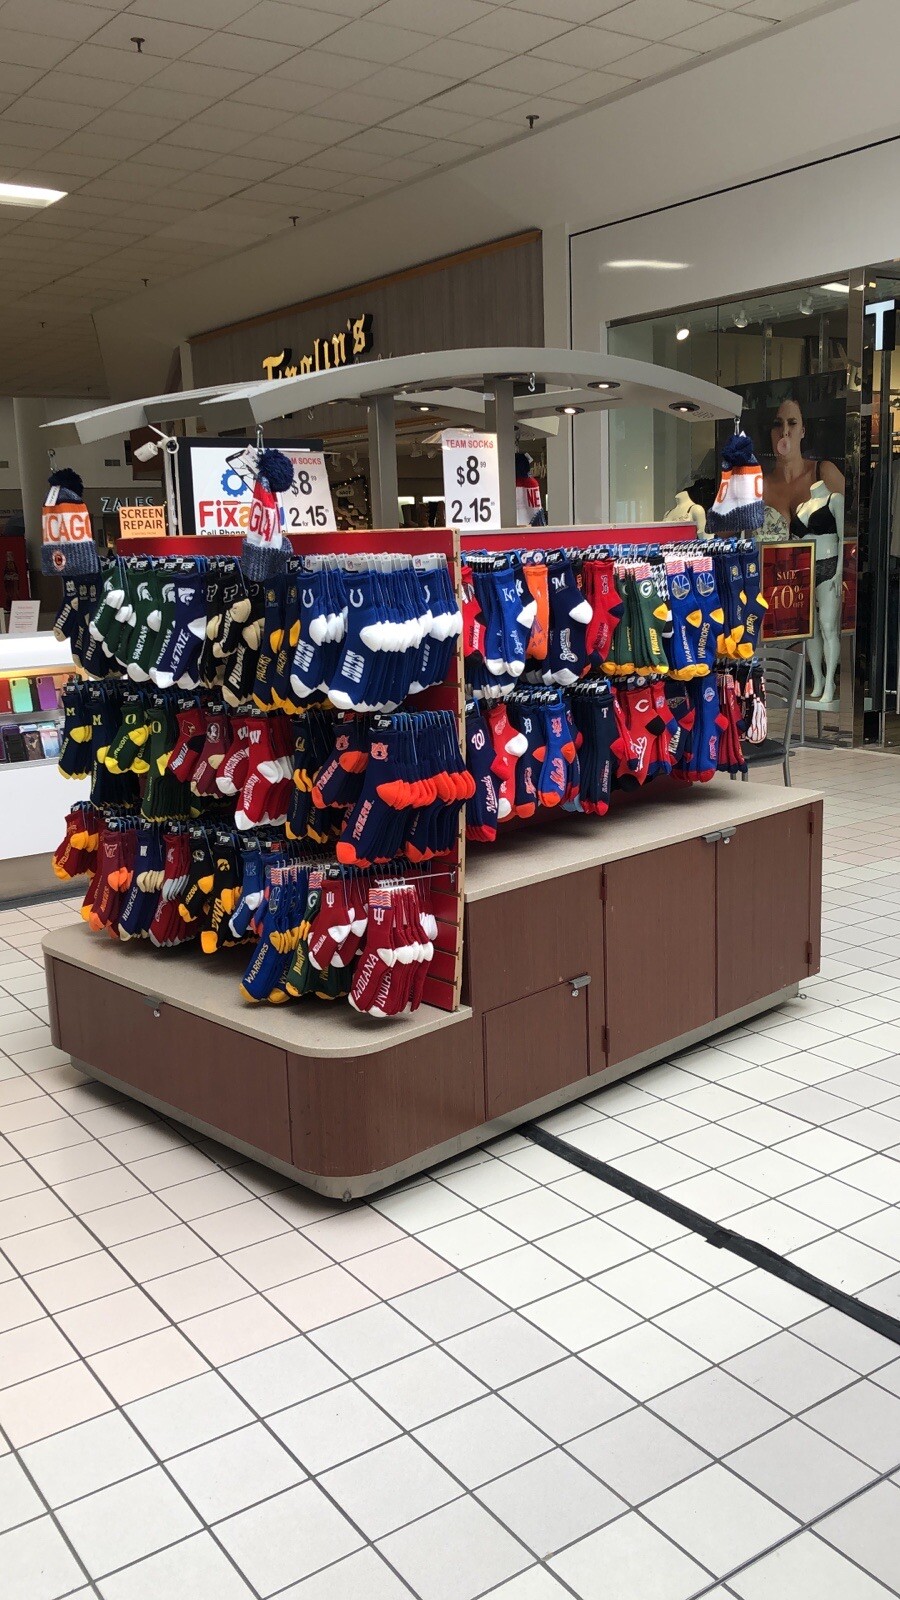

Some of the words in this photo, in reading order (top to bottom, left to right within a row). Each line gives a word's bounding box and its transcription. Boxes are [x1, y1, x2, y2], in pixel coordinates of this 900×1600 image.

[446, 439, 466, 449] TEAM
[467, 440, 494, 449] SOCKS
[298, 457, 322, 465] SOCKS
[101, 496, 154, 512] ZALES
[121, 508, 163, 519] SCREEN
[451, 500, 464, 523] 2
[123, 519, 163, 530] REPAIR
[289, 507, 301, 527] 2
[777, 570, 798, 581] SALE
[55, 603, 72, 629] IRISH
[132, 624, 148, 661] SPARTANS
[169, 629, 189, 673] K-STATE
[697, 622, 711, 660] WARRIORS
[255, 653, 272, 684] PACERS
[341, 649, 365, 684] COLTS
[66, 707, 75, 716] M
[601, 707, 609, 719] T
[634, 698, 650, 713] C
[92, 714, 103, 726] M
[125, 713, 137, 725] O
[152, 720, 162, 734] O
[249, 729, 262, 745] W
[471, 729, 485, 751] W
[316, 759, 338, 791] TIGERS
[550, 757, 565, 791] Mets
[243, 773, 260, 811] WISCONSIN
[481, 775, 498, 814] Nationals
[352, 799, 372, 841] TIGERS
[121, 886, 138, 921] HUSKIES
[312, 934, 327, 955] INDIANA
[244, 943, 269, 984] WARRIORS
[353, 953, 379, 1001] INDIANA
[375, 968, 392, 1008] INDIA
